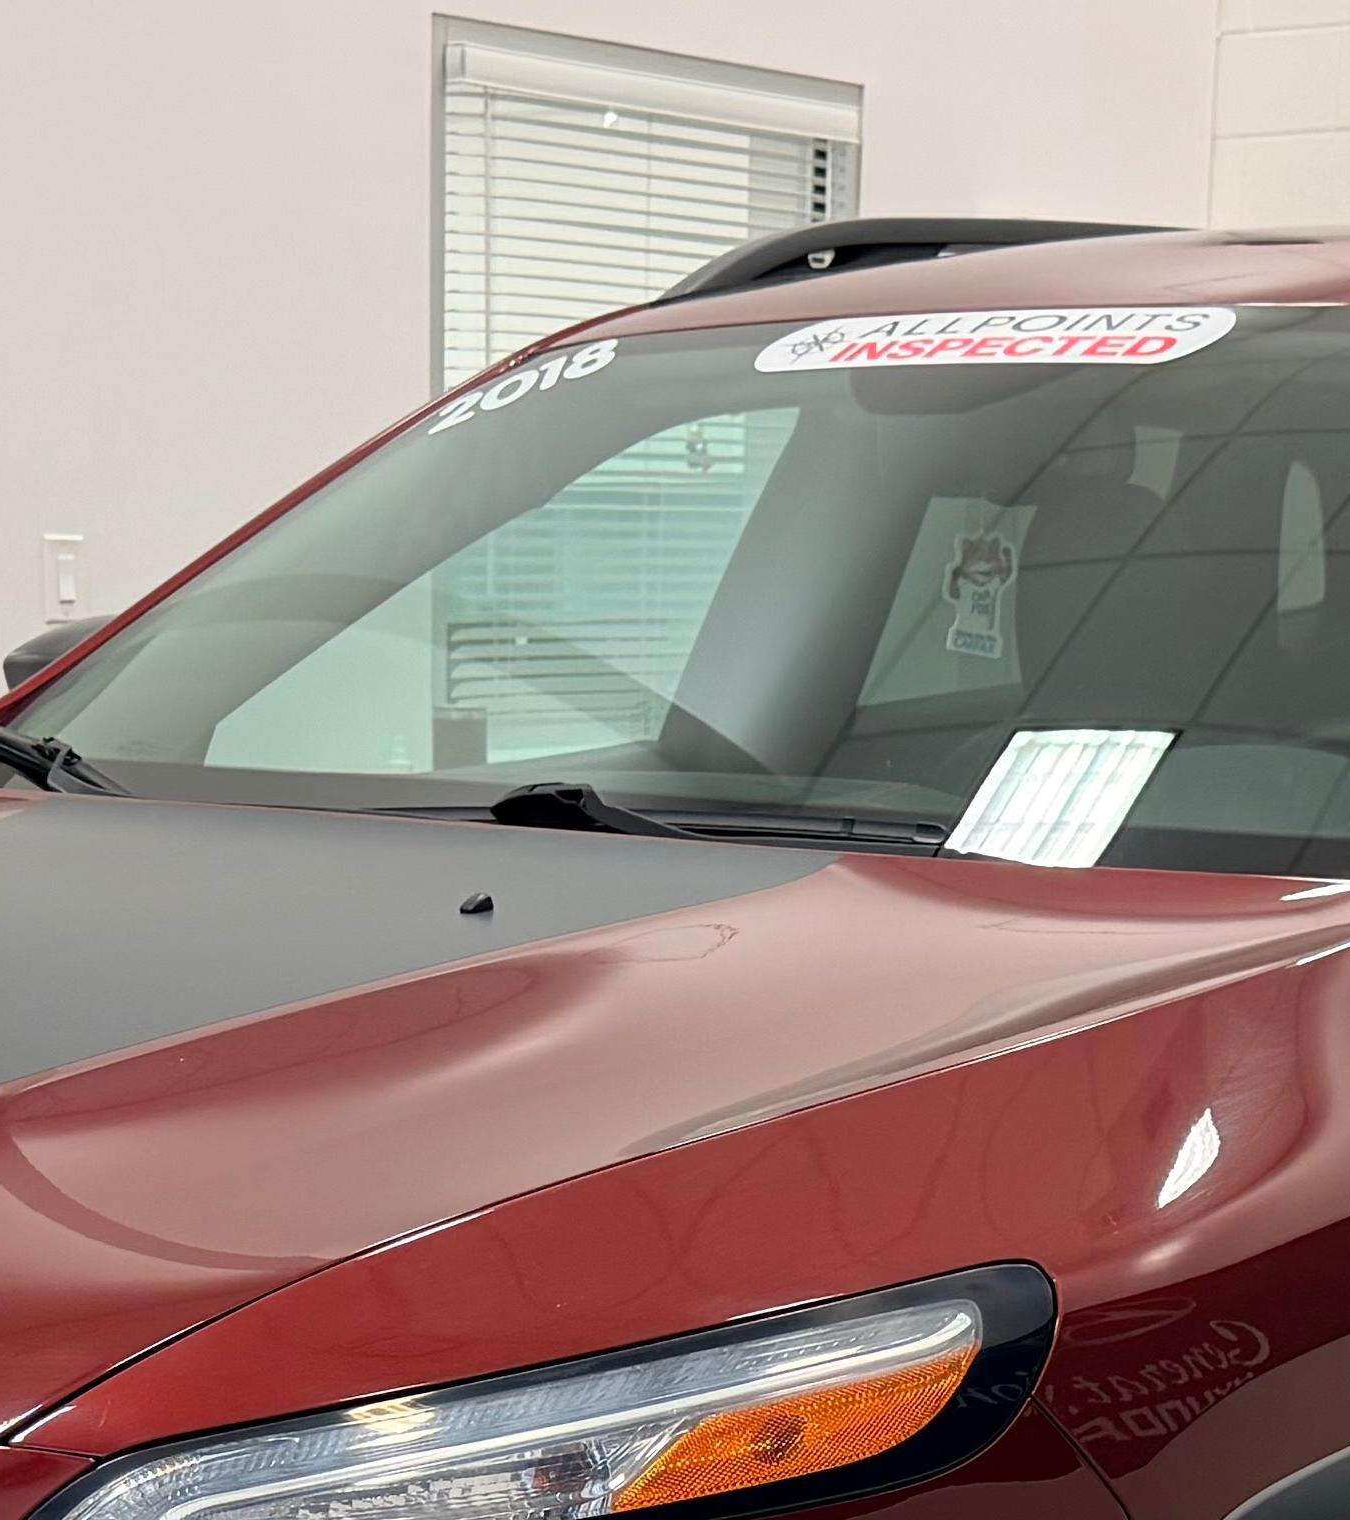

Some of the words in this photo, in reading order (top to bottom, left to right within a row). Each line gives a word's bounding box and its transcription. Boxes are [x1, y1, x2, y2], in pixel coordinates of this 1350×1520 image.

[853, 312, 1211, 341] ALLPOINTS
[829, 334, 1178, 363] INSPECTED
[428, 338, 618, 435] 2018
